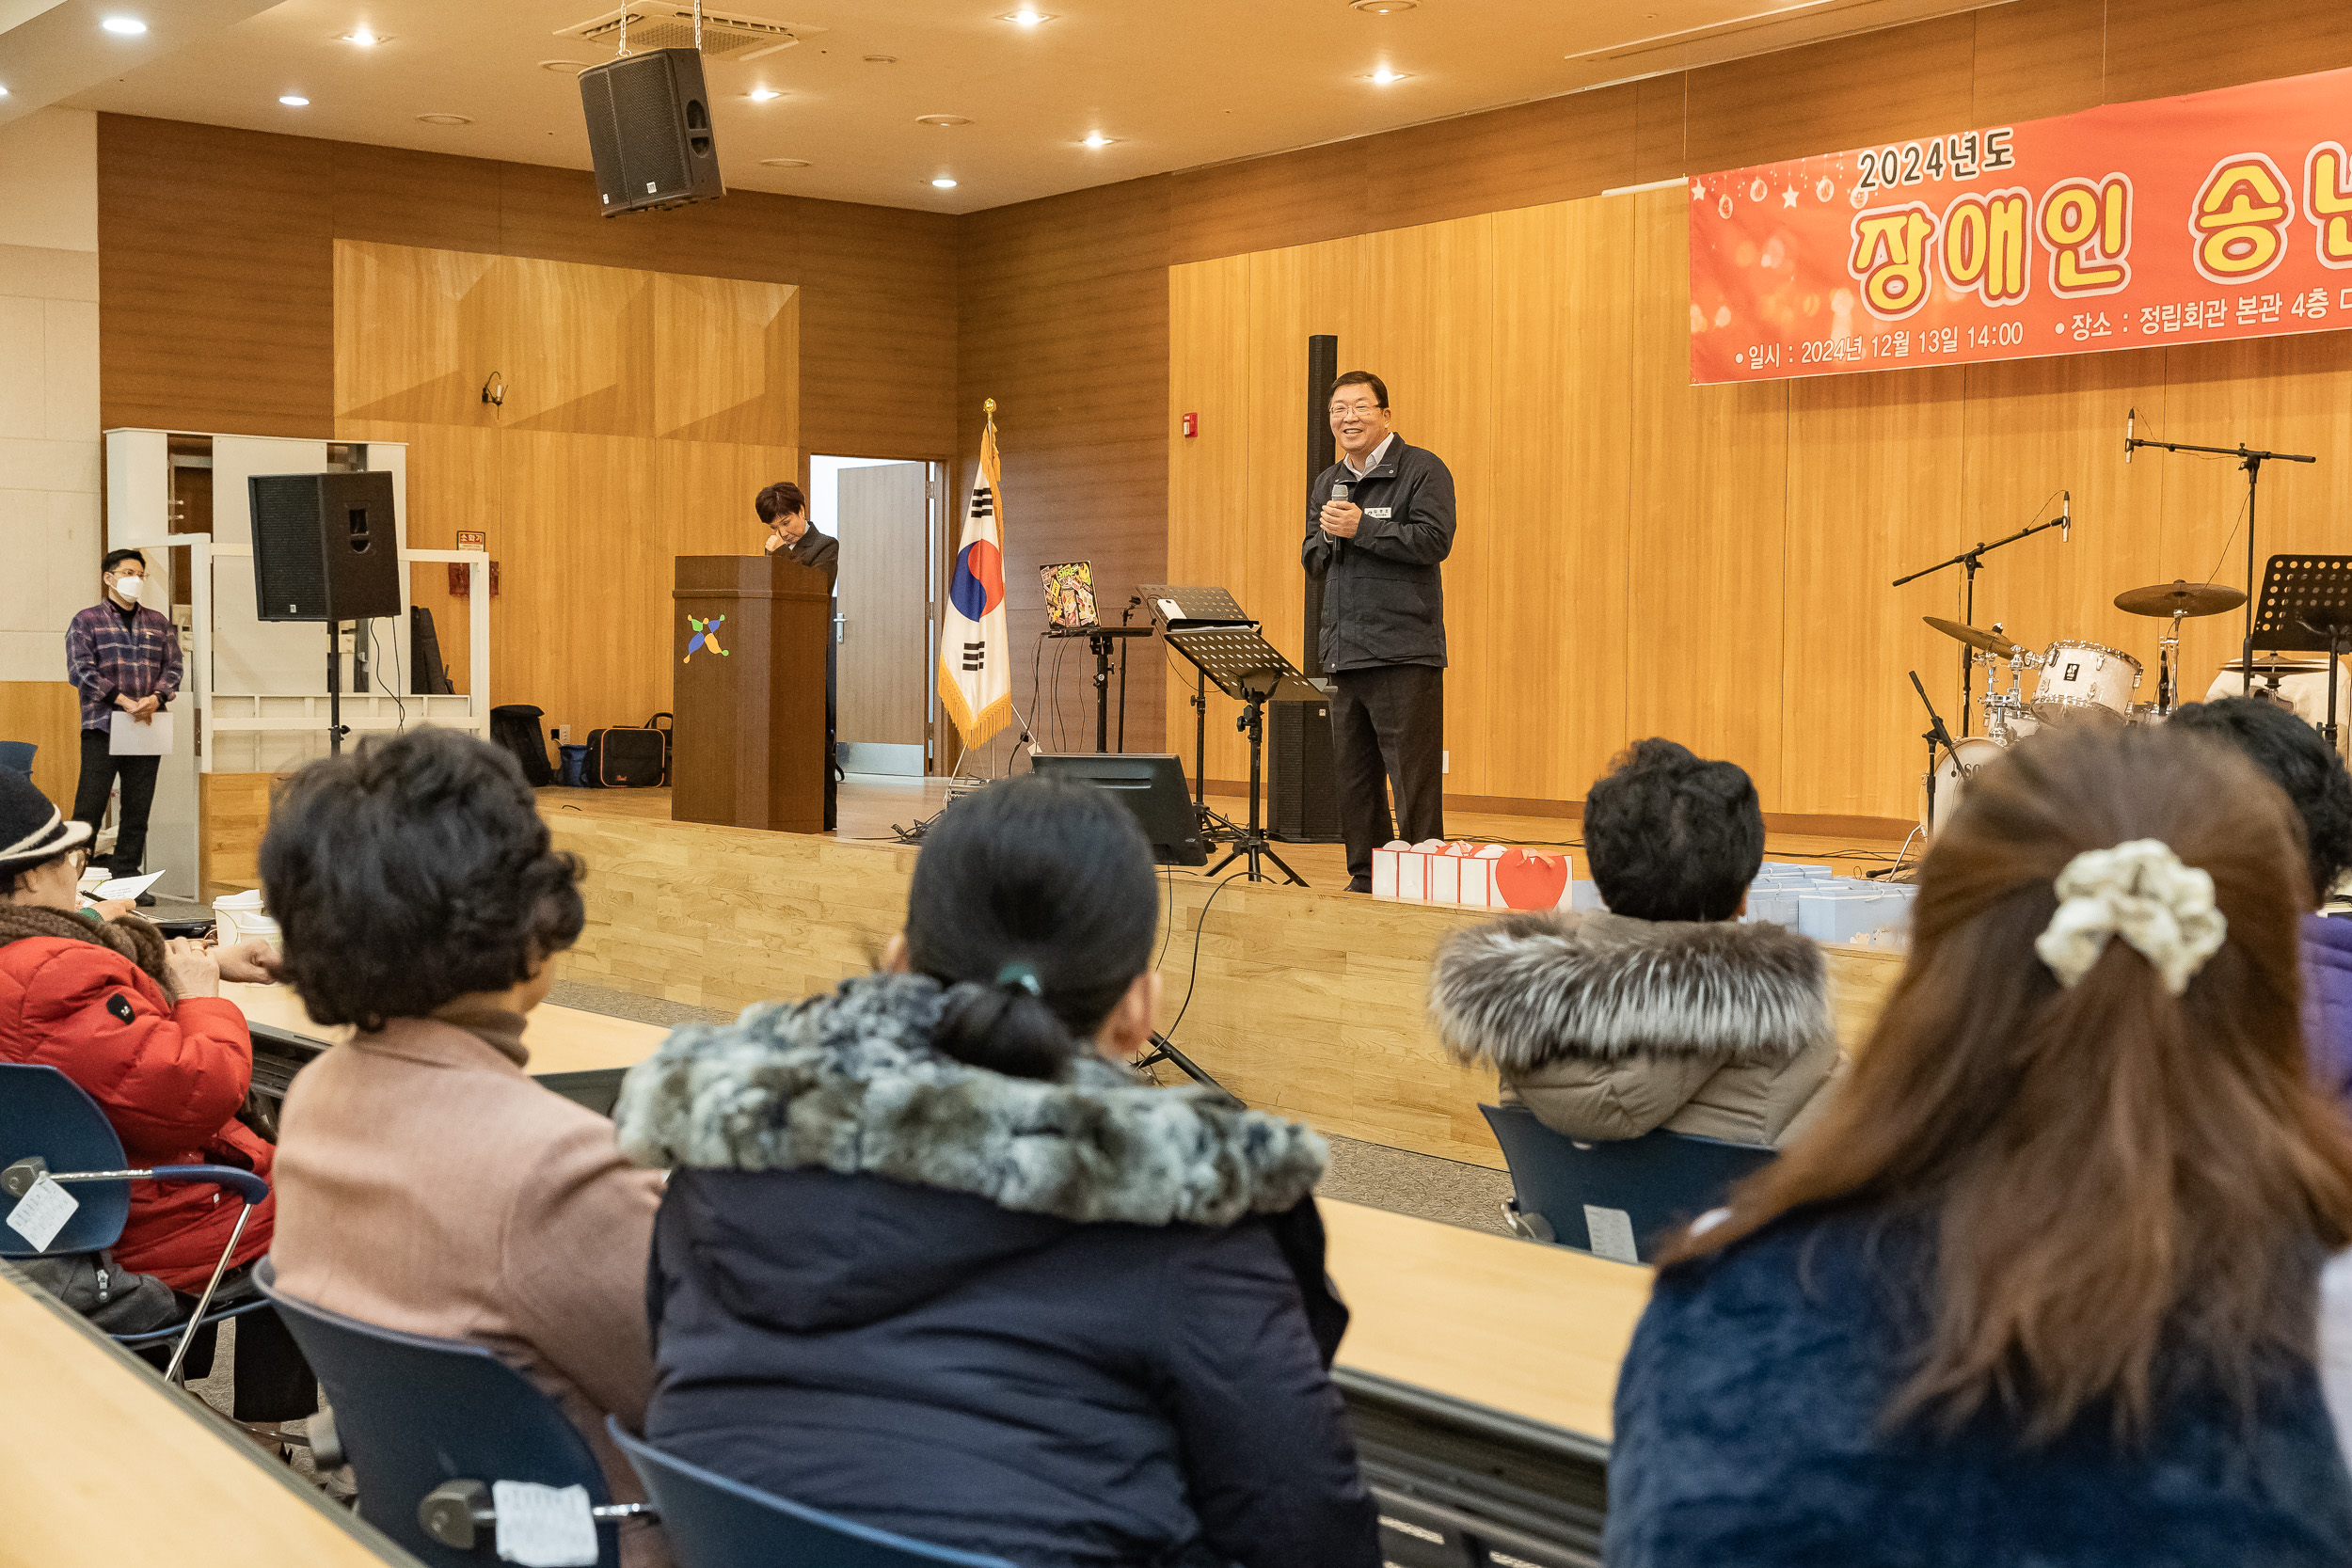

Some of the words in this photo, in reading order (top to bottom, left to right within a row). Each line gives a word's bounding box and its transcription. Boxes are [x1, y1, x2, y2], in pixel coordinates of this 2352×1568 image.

[1859, 129, 2013, 189] 2024년도
[1849, 172, 2131, 320] 장애인
[2071, 311, 2113, 341] 장소
[2138, 297, 2229, 336] 정립회관
[2235, 292, 2283, 325] 본관
[2291, 287, 2329, 320] 4층
[1748, 343, 1781, 370] 일시
[1801, 335, 1862, 364] 2024년
[1871, 330, 1910, 358] 12월
[1918, 325, 1959, 355] 13일
[1967, 321, 2024, 349] 14:00
